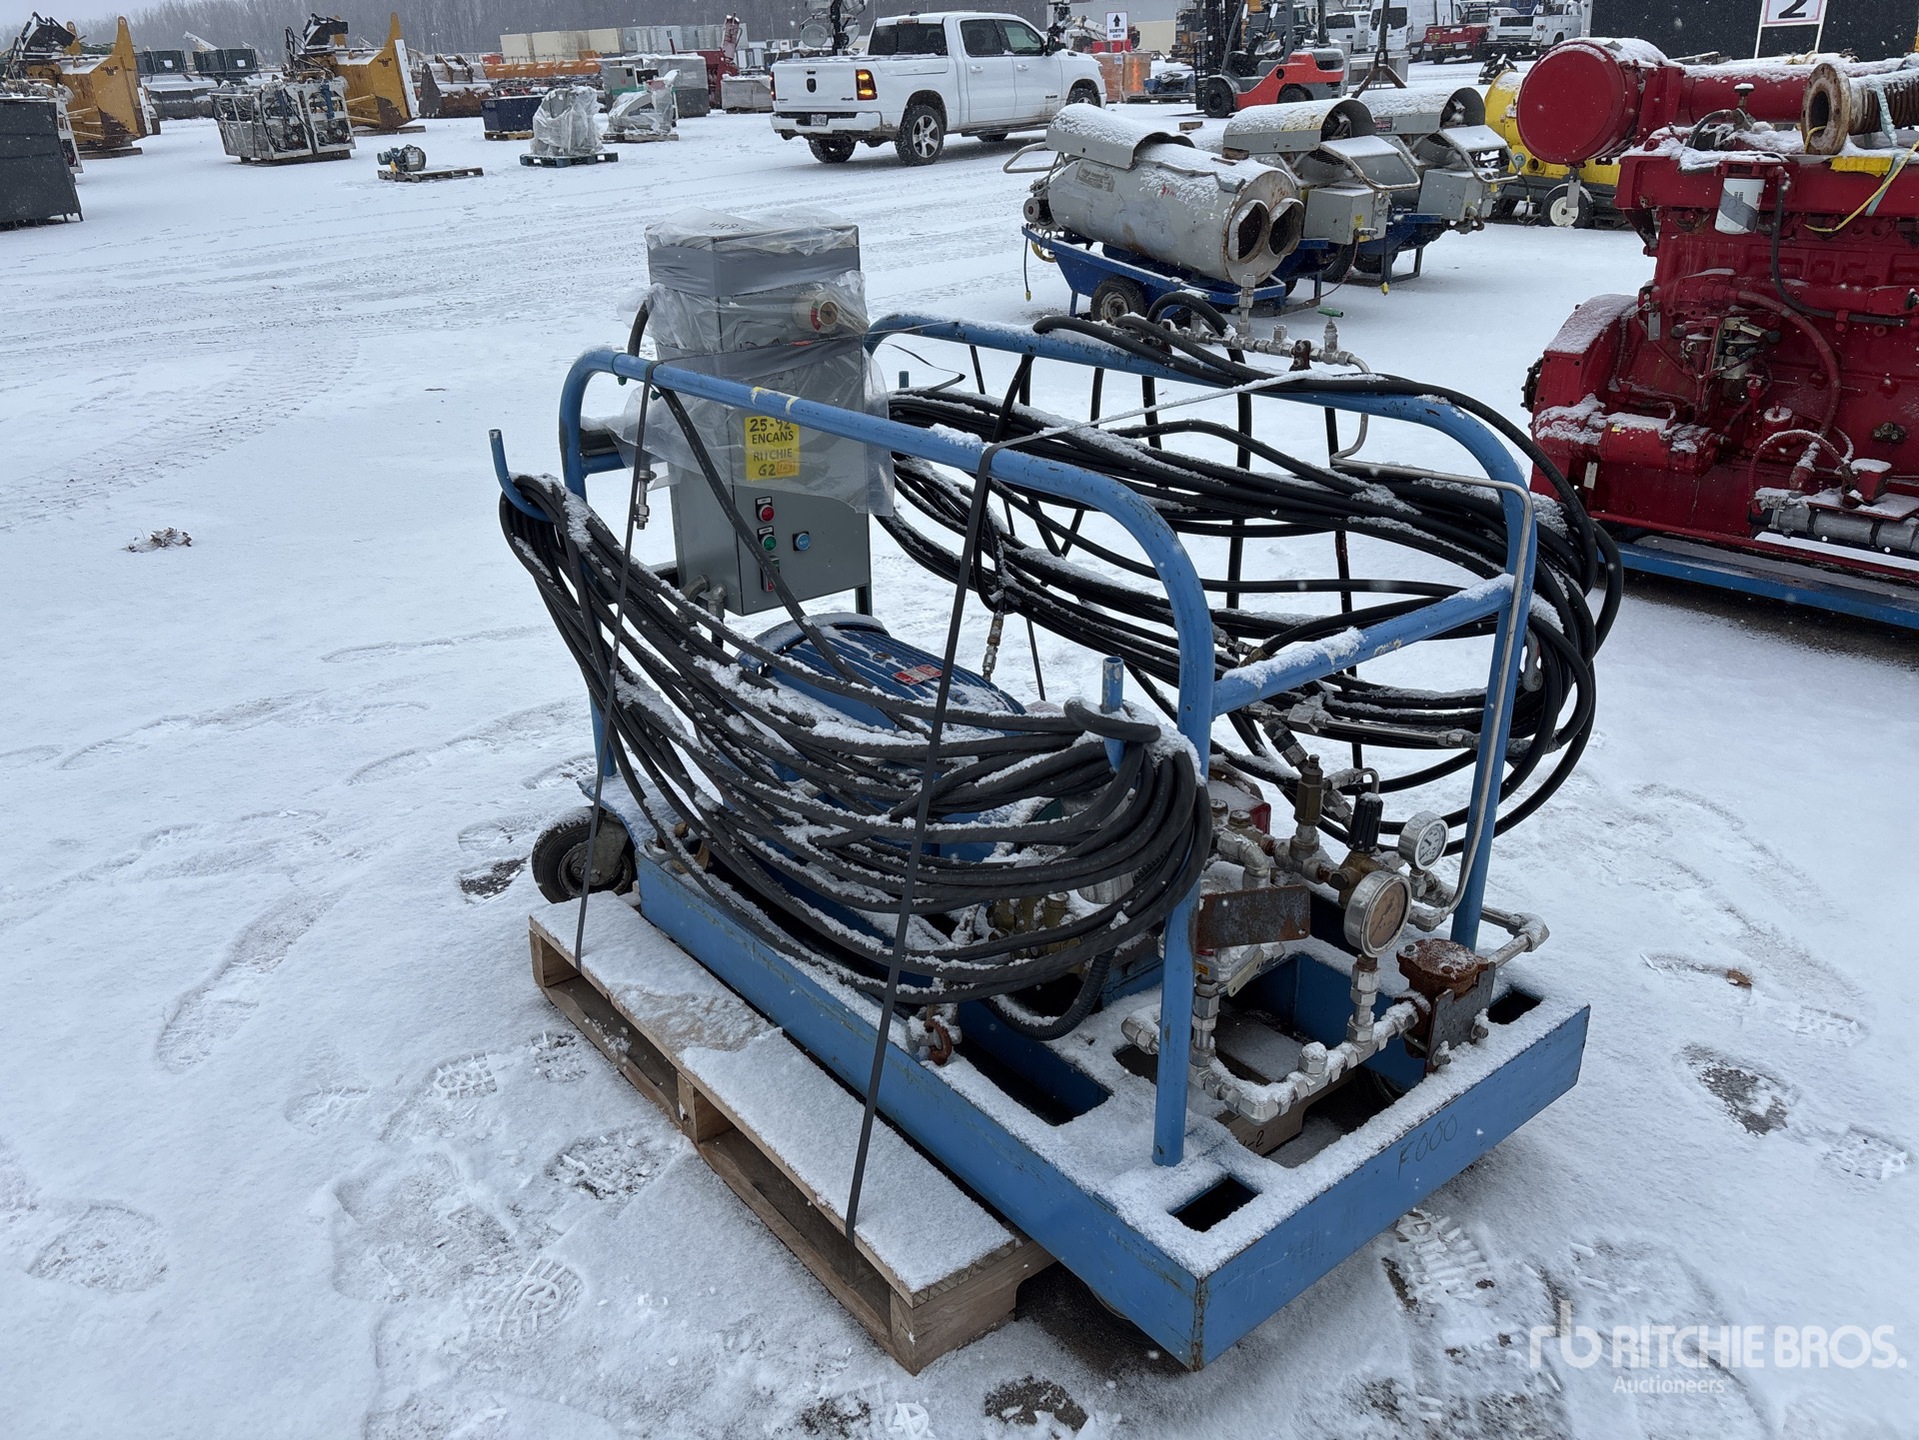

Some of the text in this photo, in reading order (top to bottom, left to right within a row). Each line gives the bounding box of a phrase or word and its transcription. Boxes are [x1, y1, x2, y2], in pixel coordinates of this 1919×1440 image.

[752, 431, 794, 444] ENCANS
[753, 448, 793, 461] RITCHIE
[758, 463, 776, 476] G2
